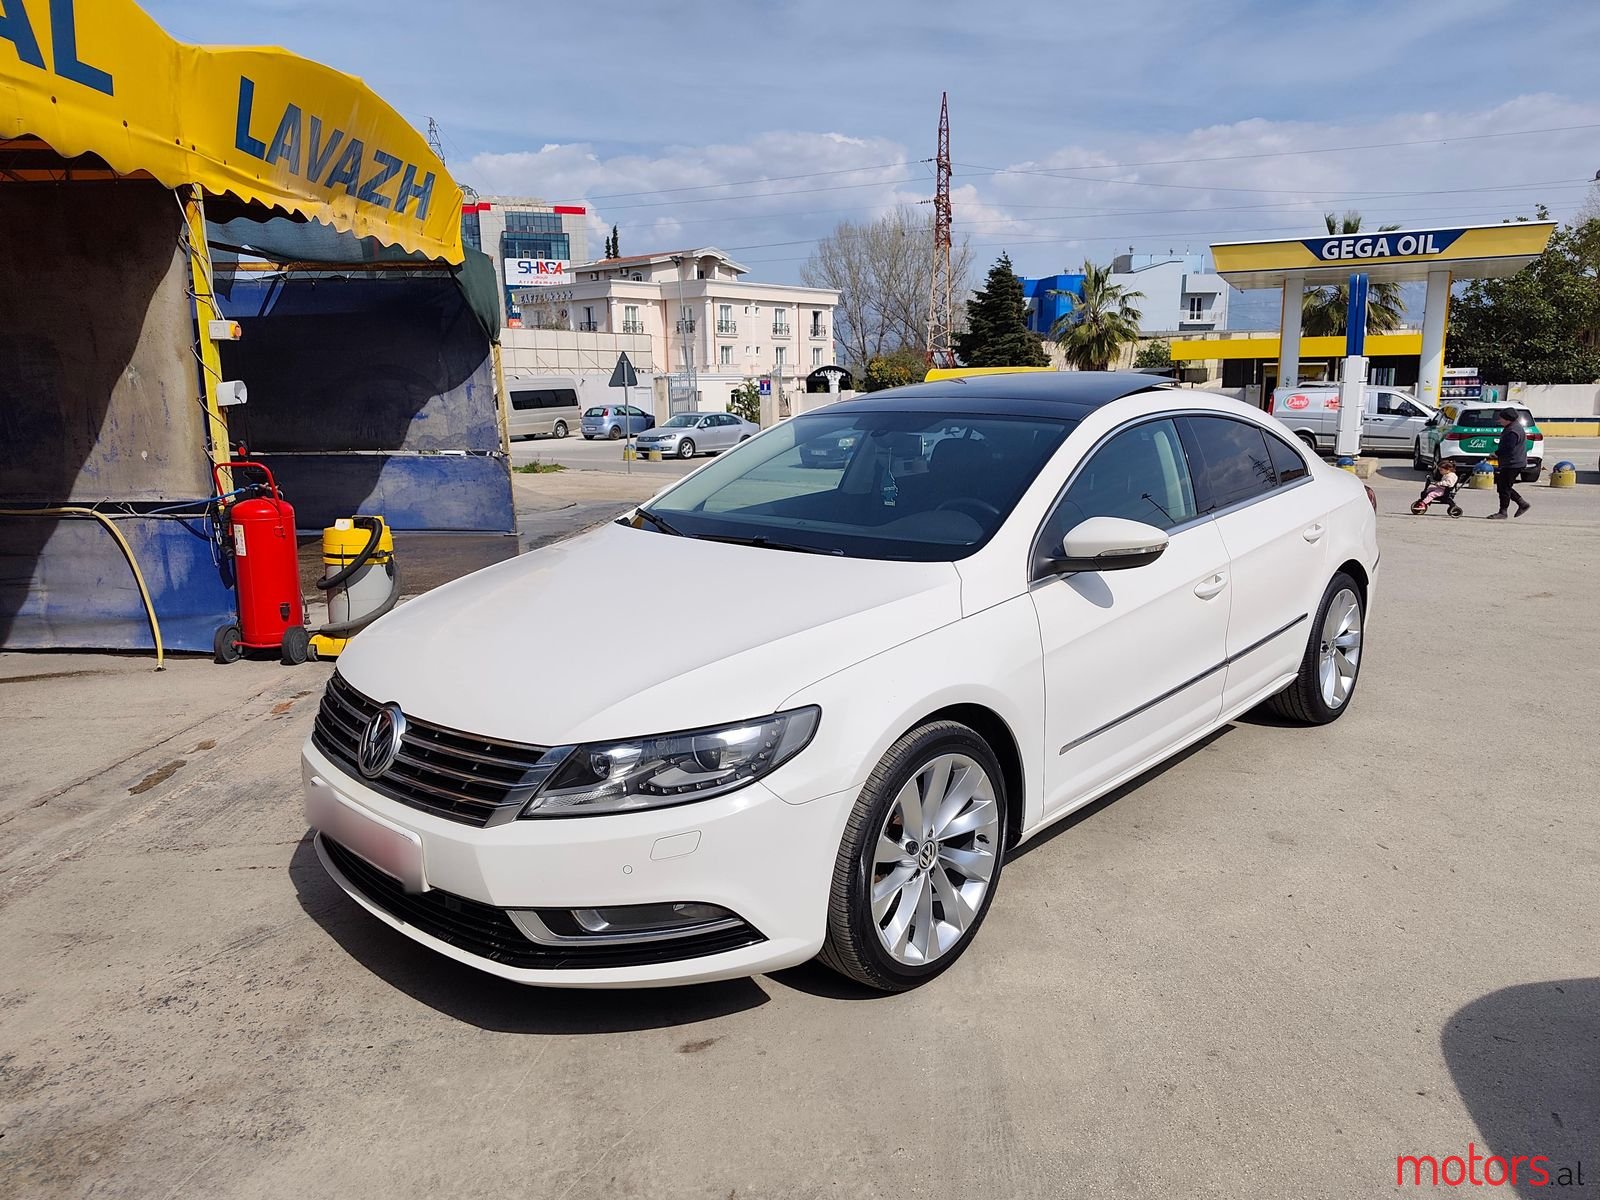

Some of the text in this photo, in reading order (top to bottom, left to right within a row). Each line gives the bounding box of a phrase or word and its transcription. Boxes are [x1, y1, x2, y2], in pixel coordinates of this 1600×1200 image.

[235, 75, 436, 221] LAVAZH
[1322, 234, 1440, 260] GEGA OIL
[517, 260, 563, 275] SHAGA
